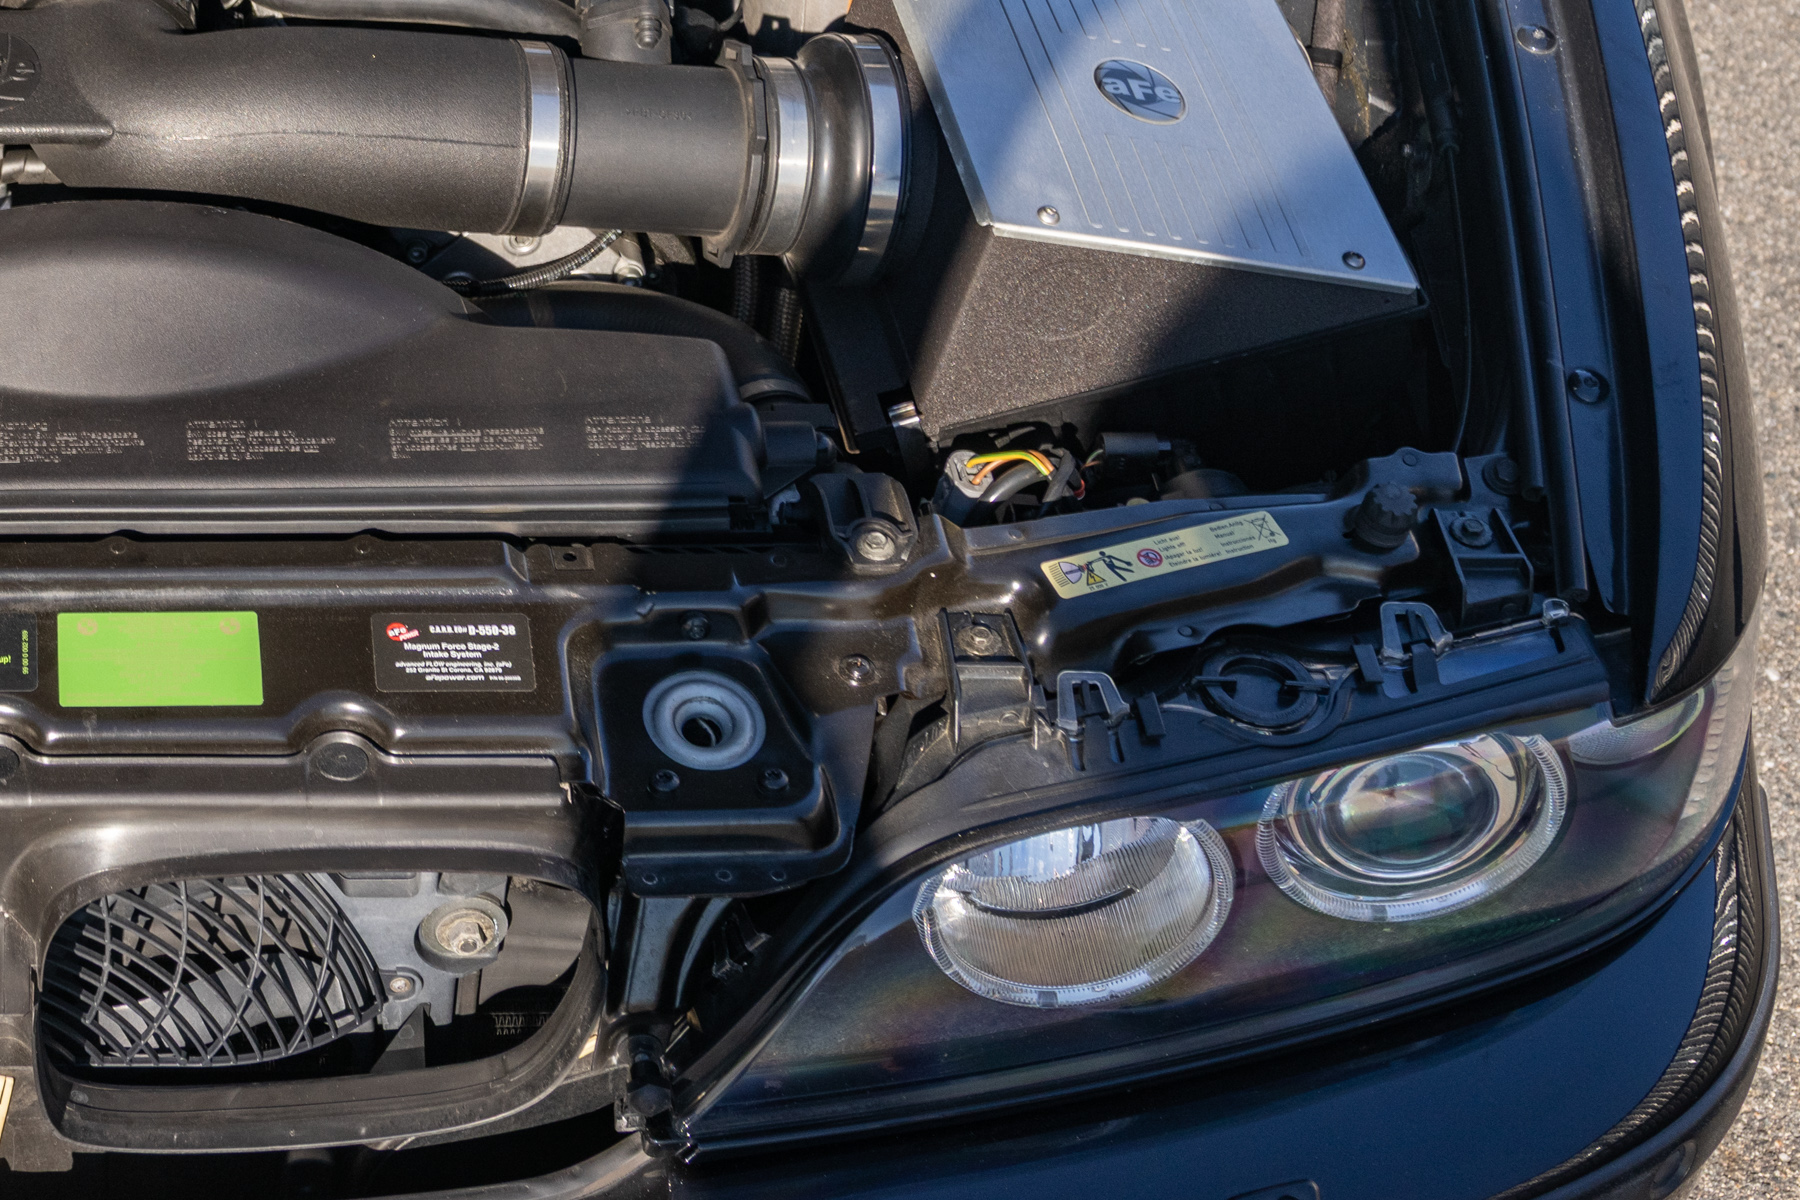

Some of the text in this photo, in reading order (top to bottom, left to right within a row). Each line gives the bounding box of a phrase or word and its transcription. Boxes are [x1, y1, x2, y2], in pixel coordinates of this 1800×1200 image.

[1102, 78, 1181, 104] aFe
[1214, 531, 1235, 539] Manual
[1154, 538, 1167, 546] Licht
[468, 625, 516, 636] D-550-38
[404, 642, 500, 652] Magnum Force Stage-2
[450, 651, 482, 659] System
[425, 674, 484, 682] aFepower.com
